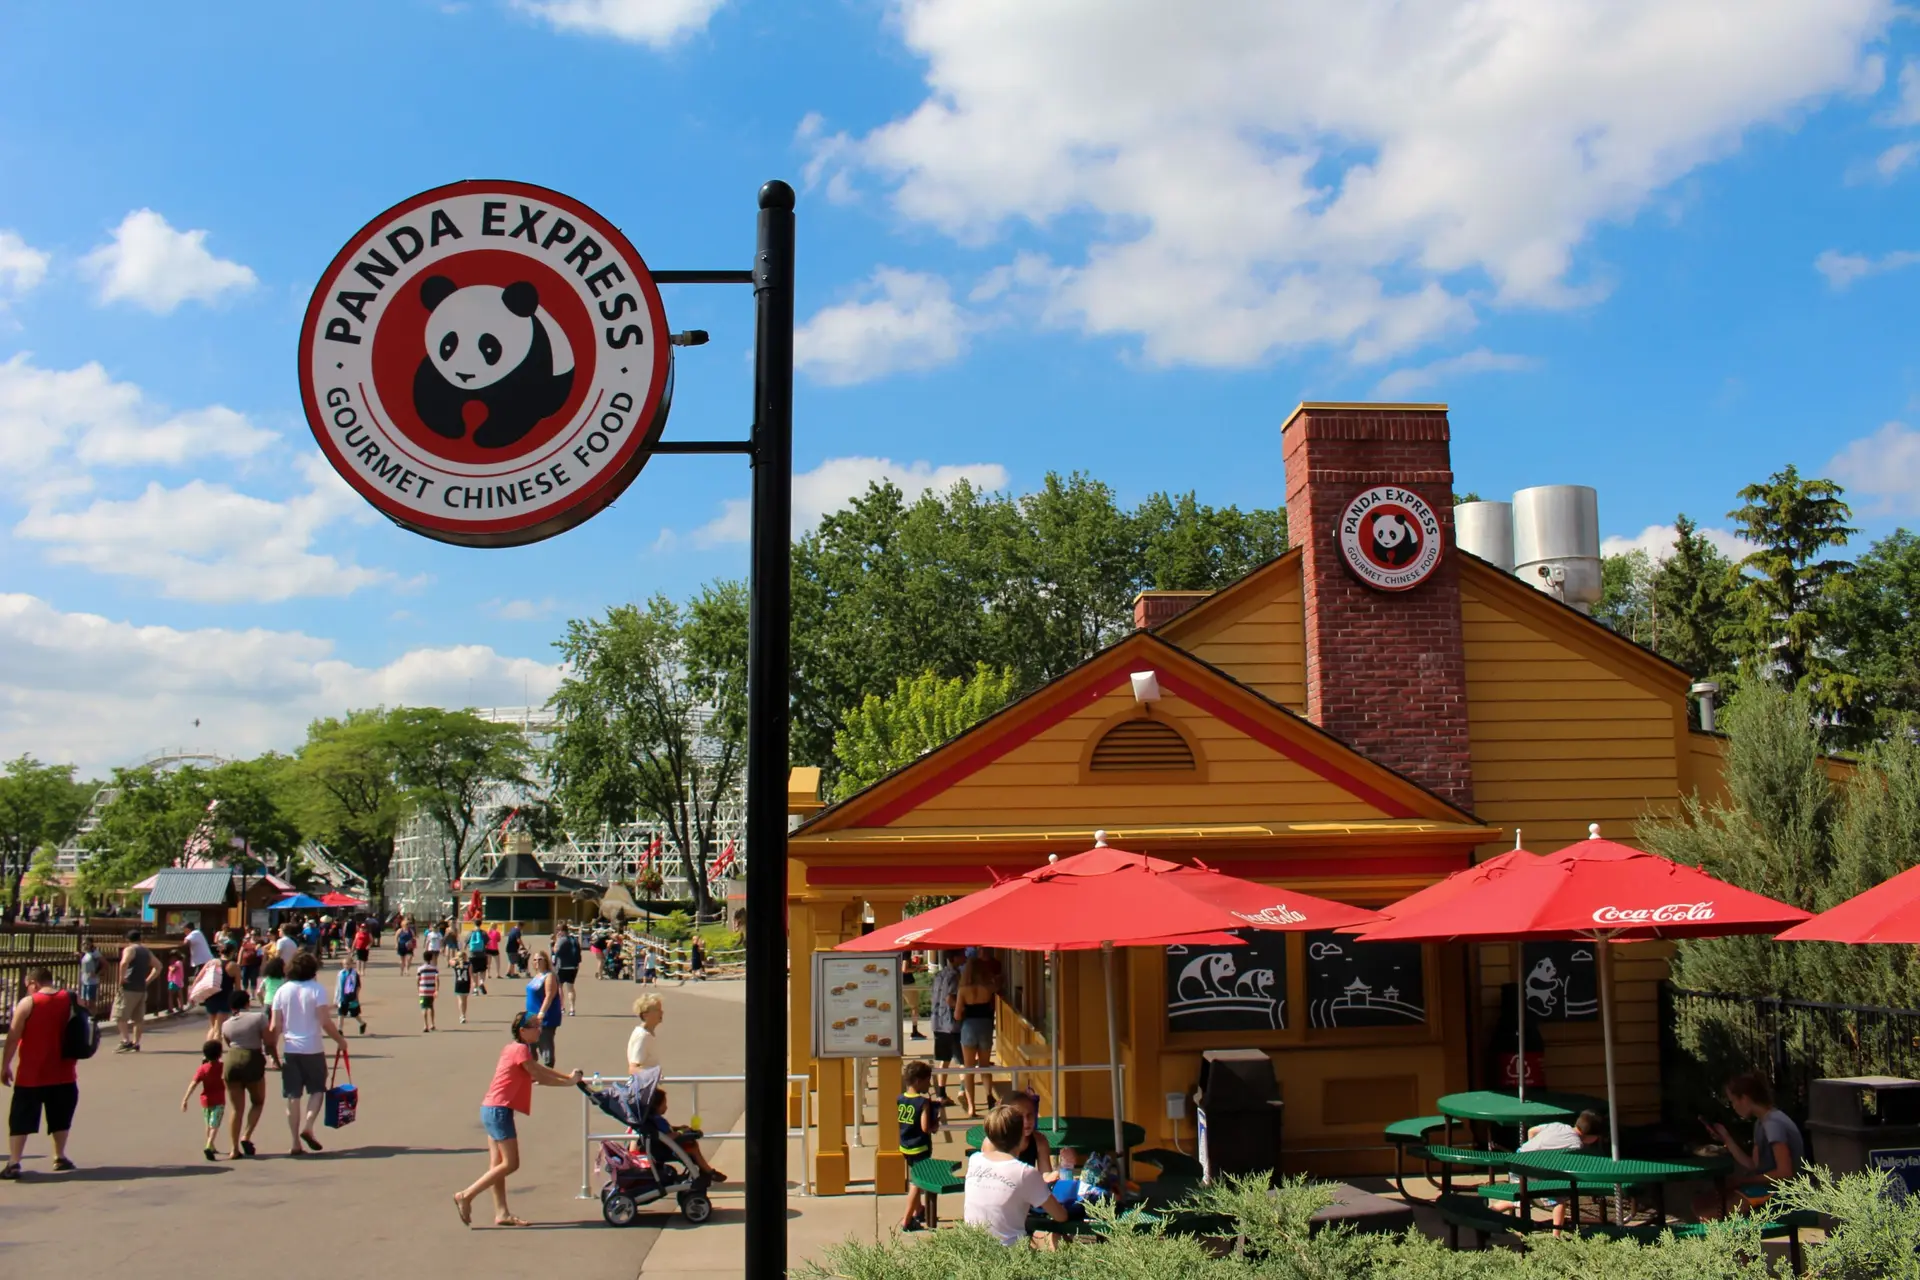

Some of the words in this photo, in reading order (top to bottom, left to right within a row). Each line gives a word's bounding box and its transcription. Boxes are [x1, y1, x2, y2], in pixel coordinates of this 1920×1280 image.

[324, 208, 463, 345] PANDA
[481, 201, 644, 350] EXPRESS
[326, 386, 436, 500] GOURMET
[443, 462, 572, 509] CHINESE
[573, 391, 634, 467] FOOD
[1344, 491, 1381, 535] PANDA
[1386, 489, 1438, 535] EXPRESS
[1347, 546, 1382, 581] GOURMET
[1384, 570, 1421, 584] CHINESE
[1421, 547, 1437, 571] FOOD
[1592, 901, 1715, 923] Coca-Cola
[456, 969, 468, 981] 14
[897, 1103, 915, 1125] 22
